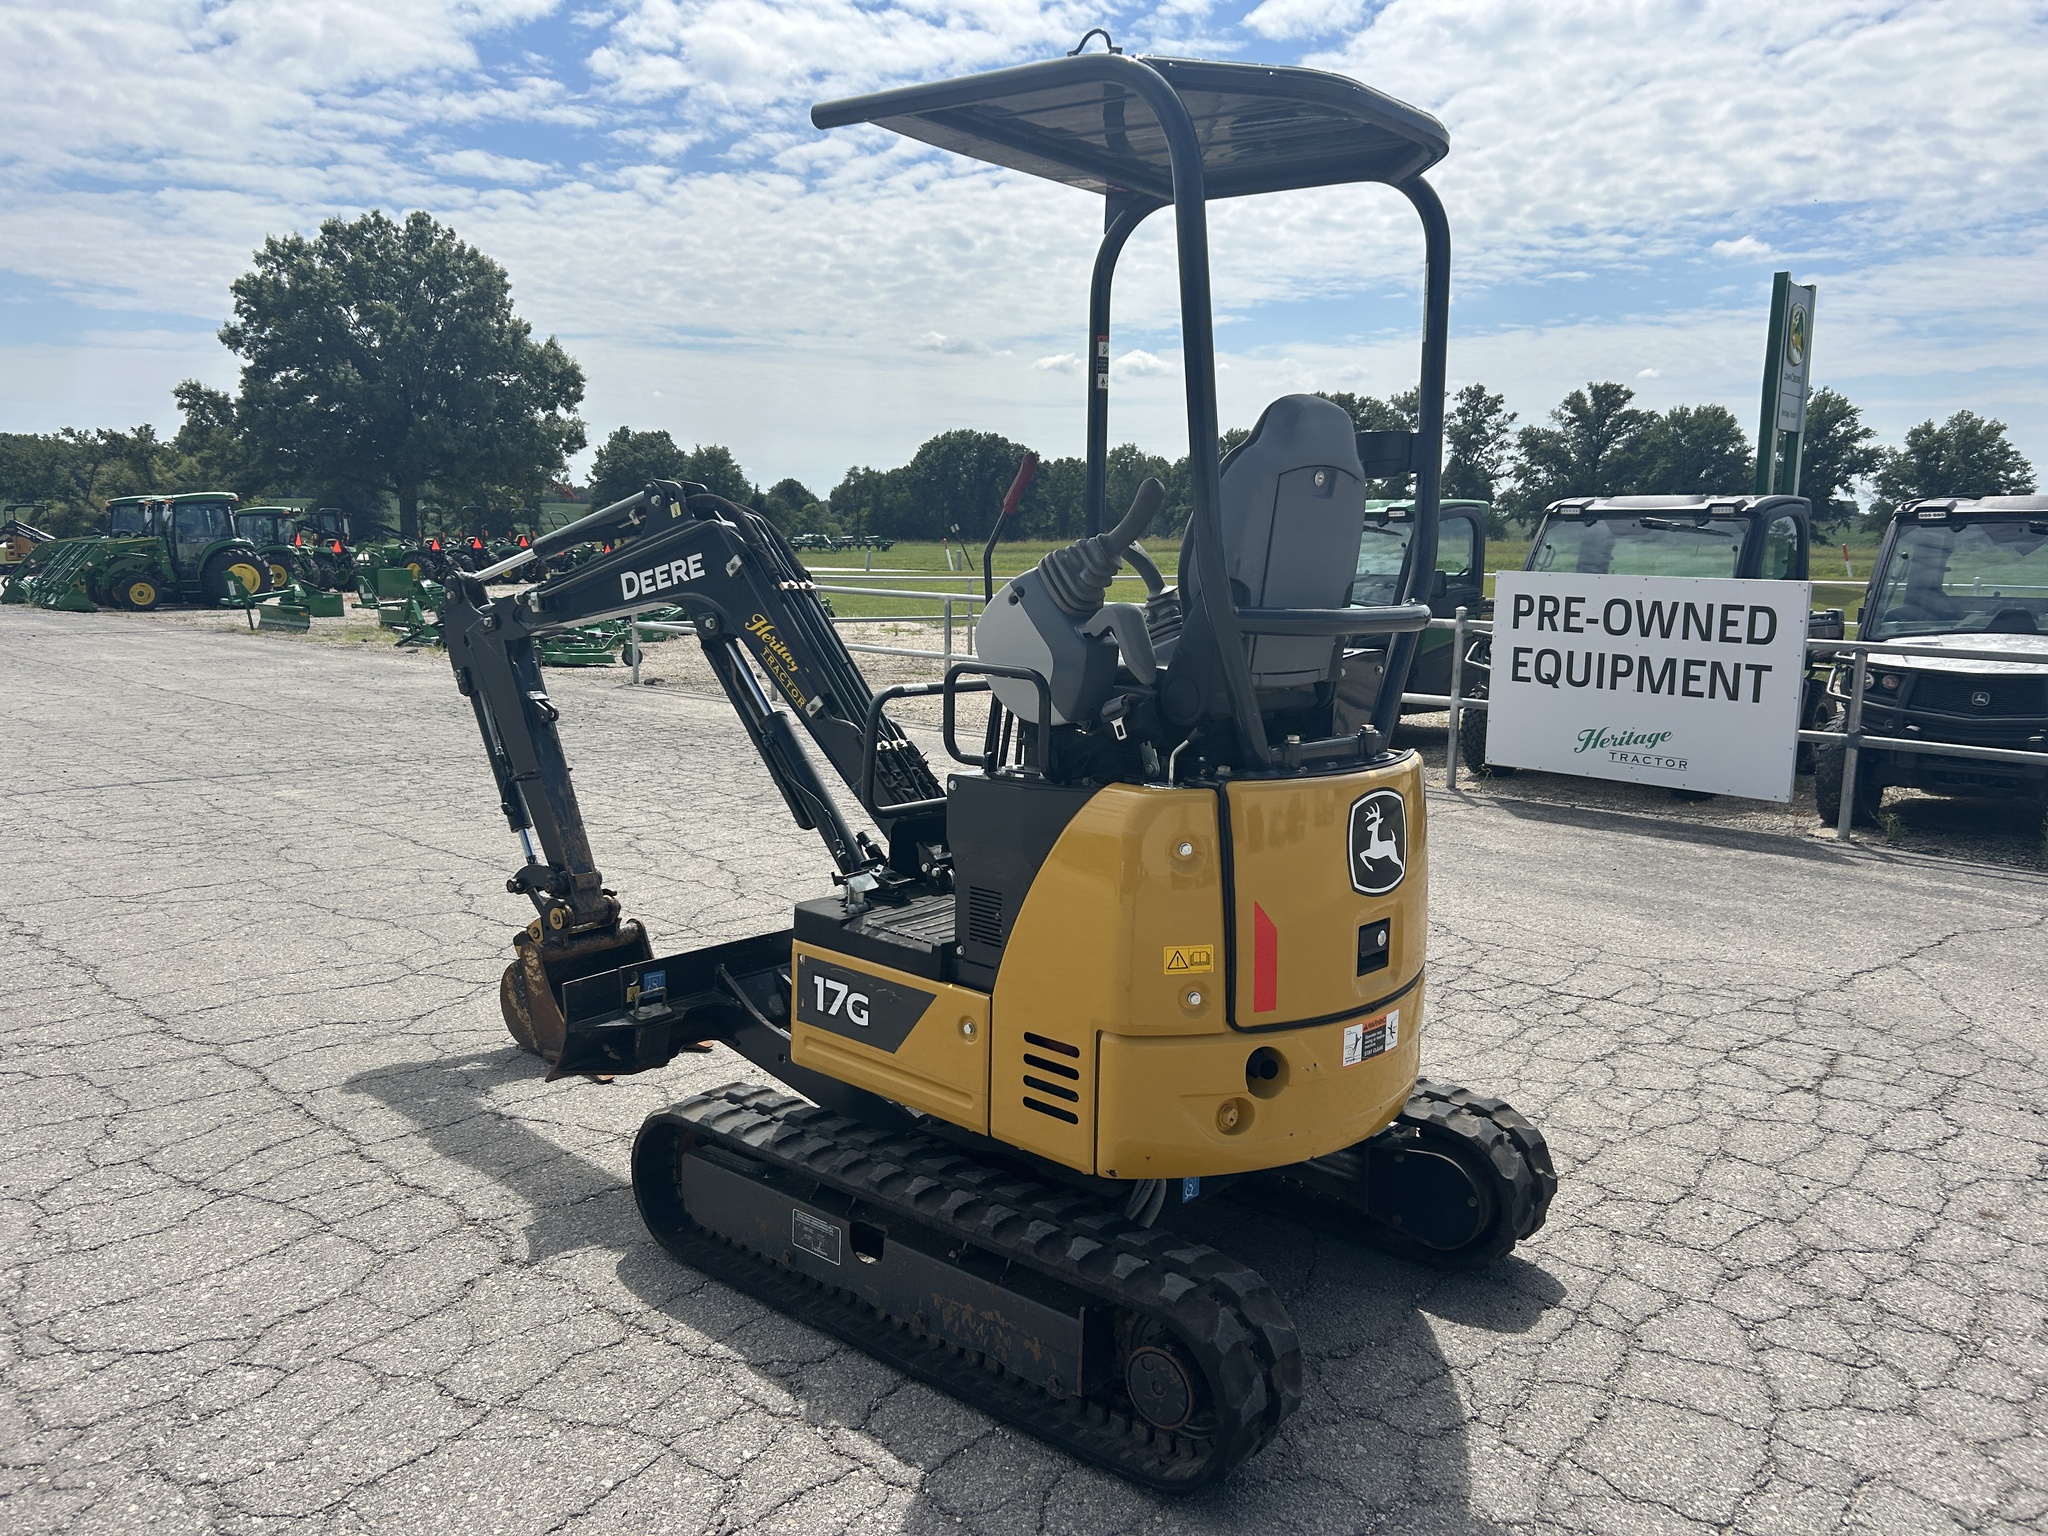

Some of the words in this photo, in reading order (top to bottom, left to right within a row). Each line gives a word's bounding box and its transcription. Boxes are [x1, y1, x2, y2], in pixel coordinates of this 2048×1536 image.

[620, 552, 706, 600] DEERE
[1512, 593, 1777, 646] PRE-OWNED
[762, 648, 806, 708] TRACTOR
[1511, 646, 1773, 704] EQUIPMENT
[1574, 726, 1673, 753] Heritage
[1609, 751, 1688, 770] TRACTOR
[813, 975, 870, 1027] 17G
